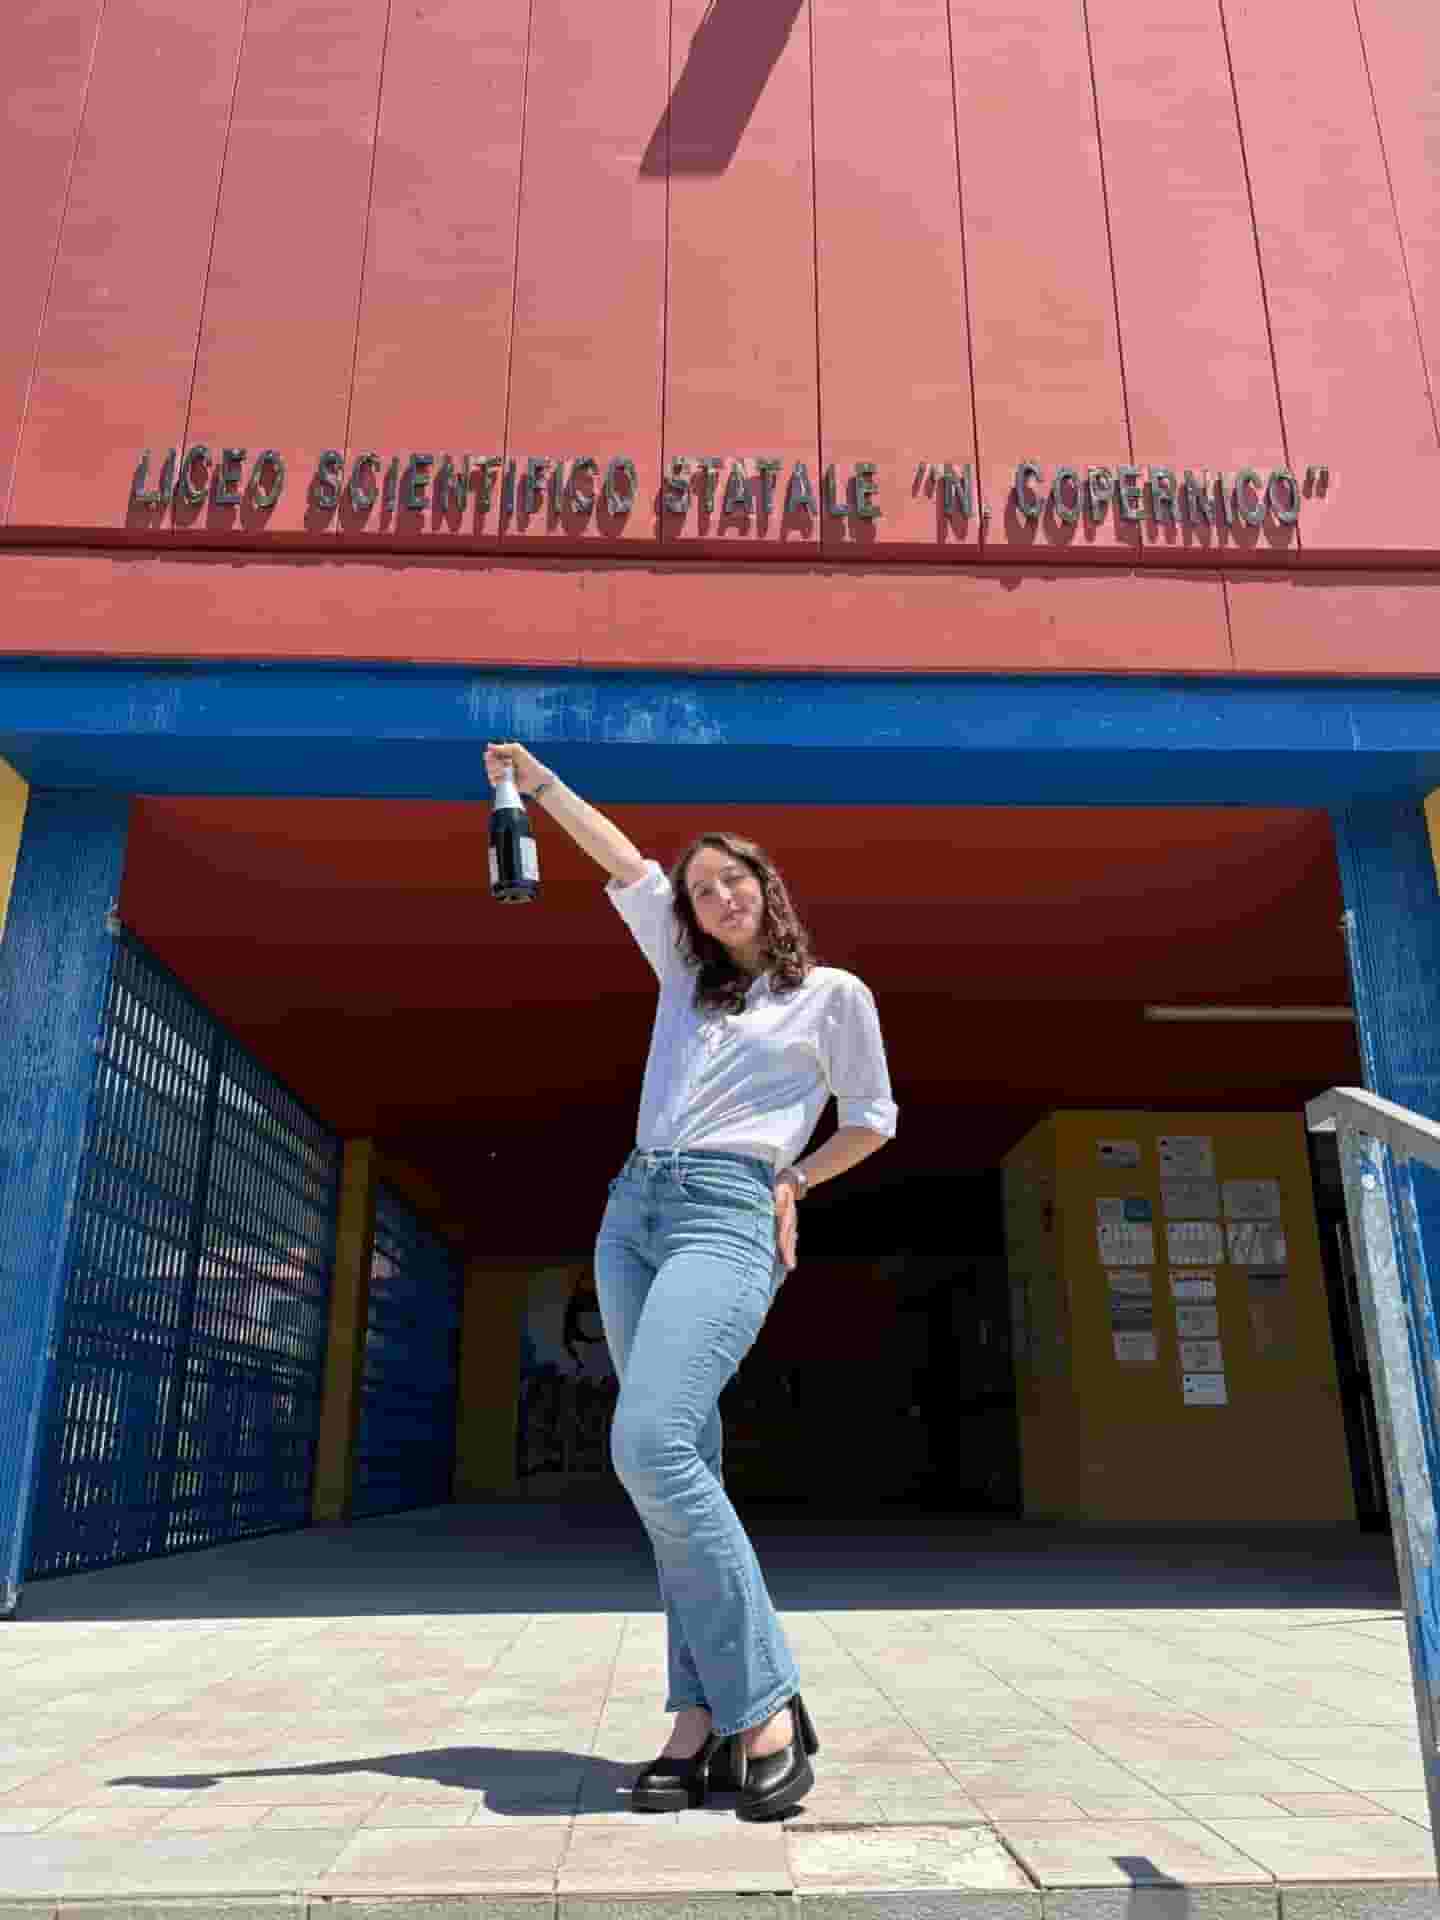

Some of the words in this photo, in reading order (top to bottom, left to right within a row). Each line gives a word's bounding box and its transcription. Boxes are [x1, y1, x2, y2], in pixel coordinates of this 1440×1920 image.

[132, 446, 286, 510] LICEO
[310, 450, 637, 513] SCIENTIFICO
[661, 456, 882, 518] STATALE
